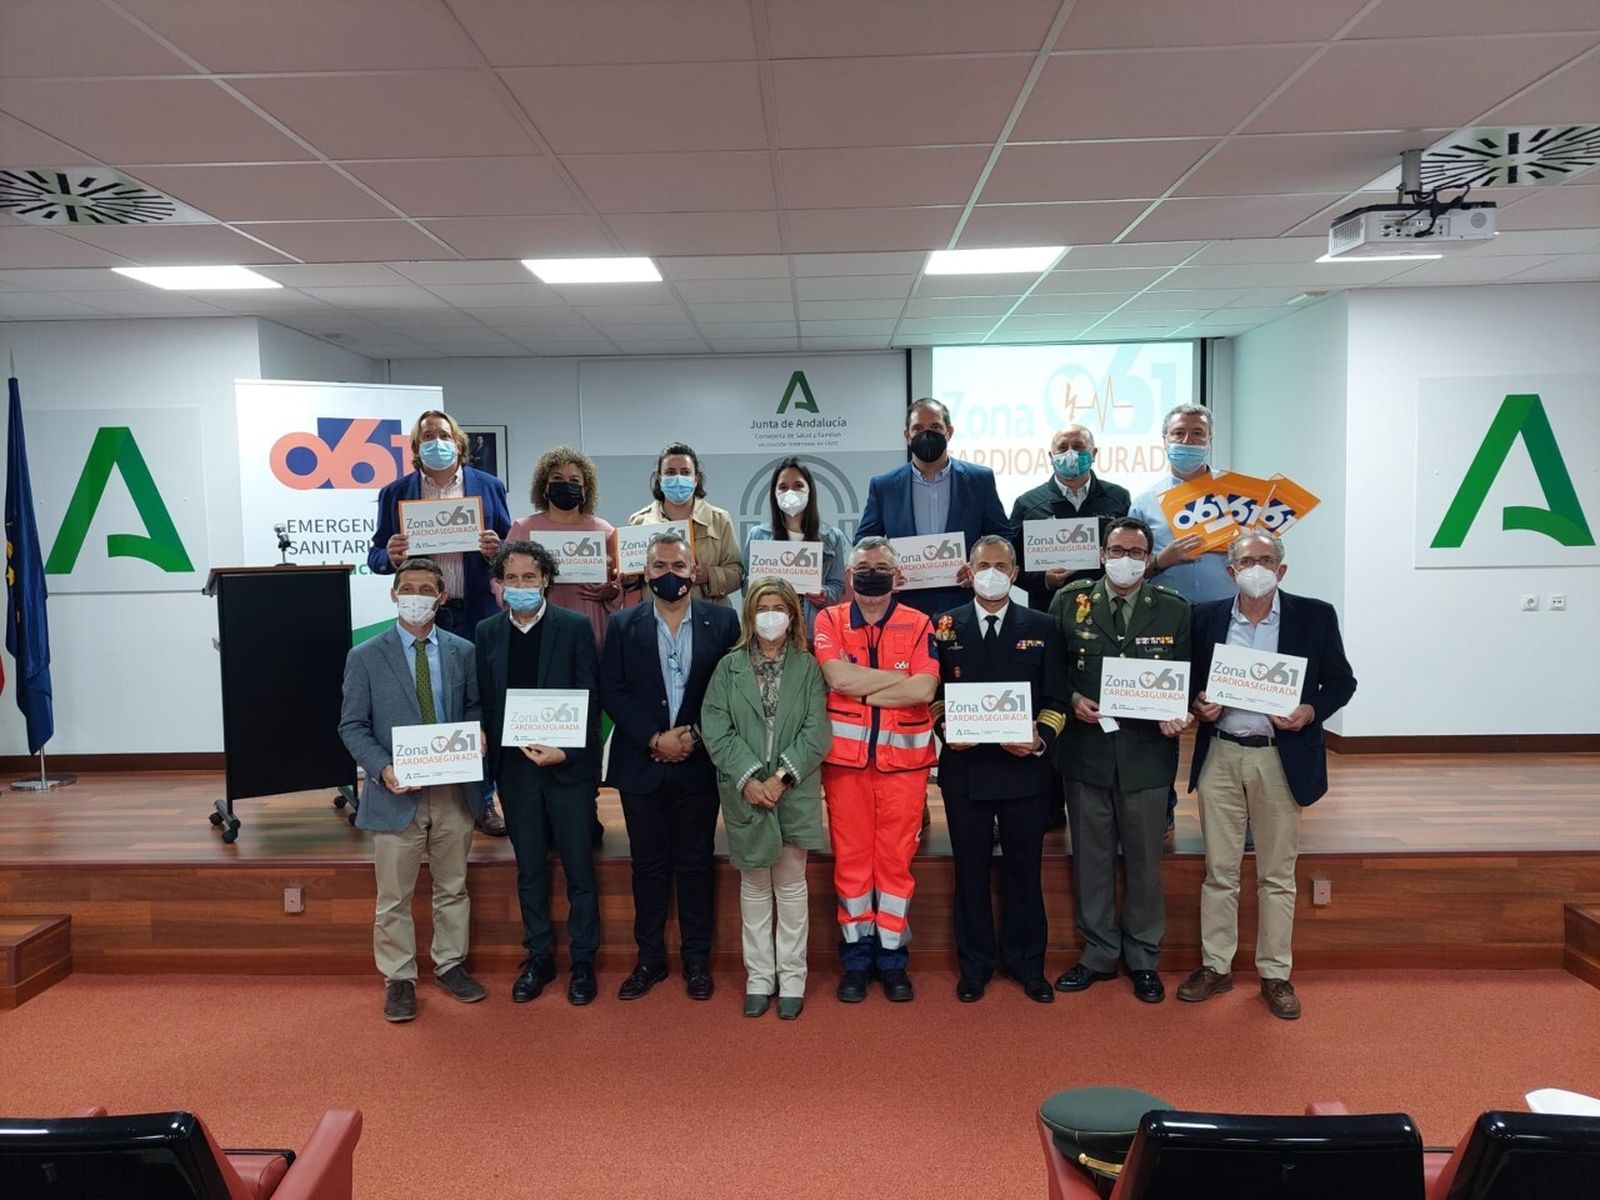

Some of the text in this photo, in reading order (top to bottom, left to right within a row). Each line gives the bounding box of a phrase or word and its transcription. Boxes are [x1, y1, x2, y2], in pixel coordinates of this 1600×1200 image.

[941, 391, 1034, 438] Zona
[750, 416, 847, 429] Junta de Andalucía
[287, 519, 374, 533] EMERGEN
[406, 518, 435, 529] Zona
[621, 541, 647, 551] Zona
[1027, 536, 1054, 546] Zona
[288, 540, 370, 555] SANITARI
[752, 555, 778, 567] Zona
[899, 560, 964, 571] ARDIOASEGURADA
[1214, 661, 1246, 678] Zona
[1104, 675, 1135, 688] Zona
[948, 701, 978, 713] Zona
[511, 712, 538, 723] Zona
[396, 745, 428, 757] Zona
